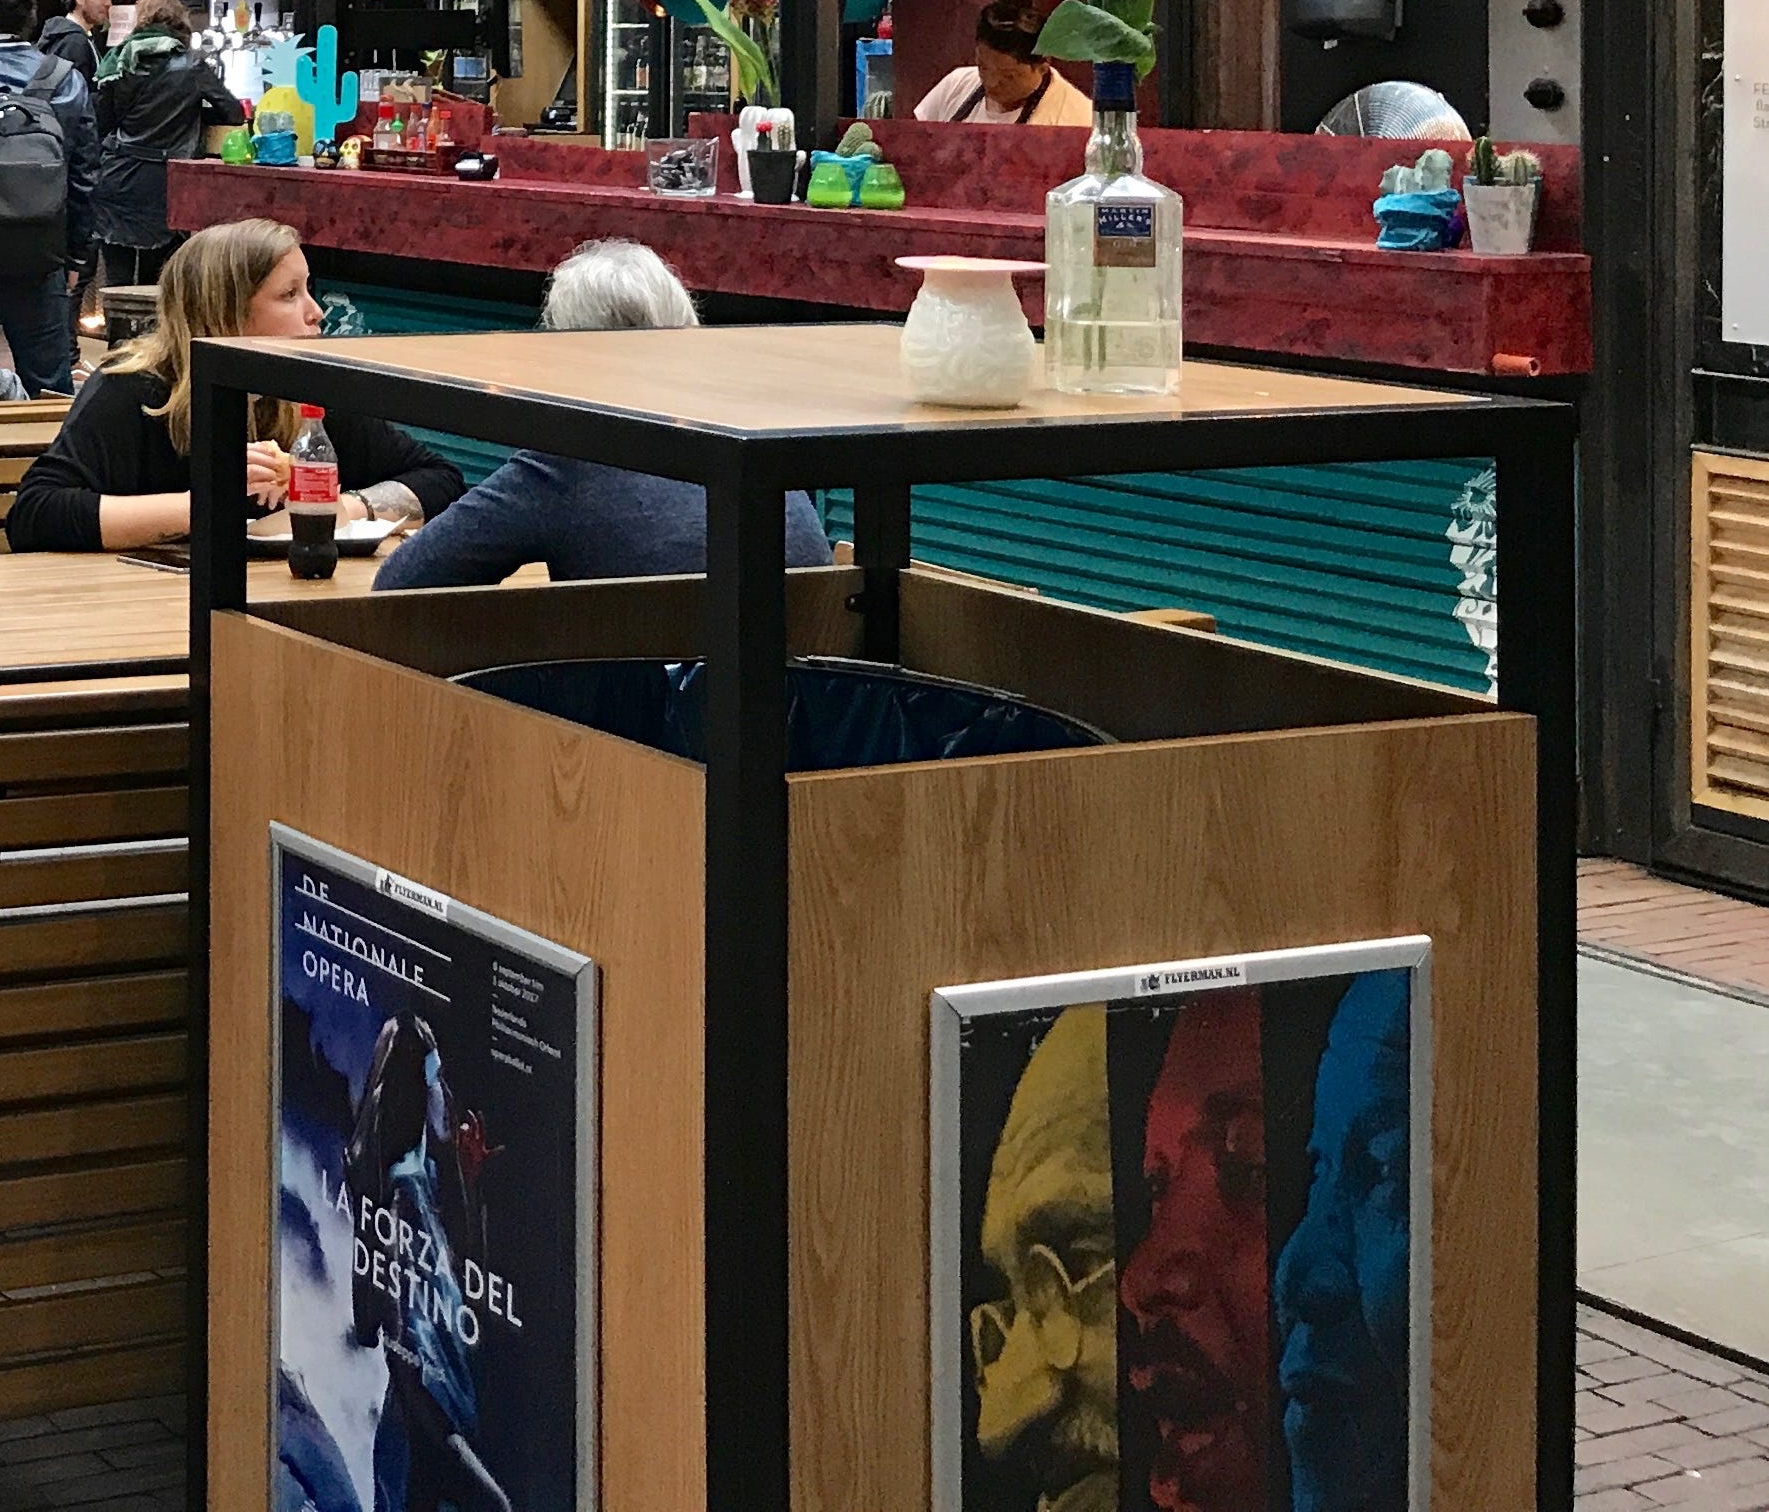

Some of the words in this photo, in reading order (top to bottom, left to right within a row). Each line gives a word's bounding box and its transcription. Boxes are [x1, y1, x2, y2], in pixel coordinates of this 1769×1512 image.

[302, 910, 425, 987] NATIONALE
[302, 949, 370, 1007] OPERA
[1164, 967, 1240, 984] FLYERMAN.NL
[353, 1236, 480, 1346] DESTINO
[361, 1194, 454, 1282] FORZA
[463, 1258, 523, 1329] DEL
